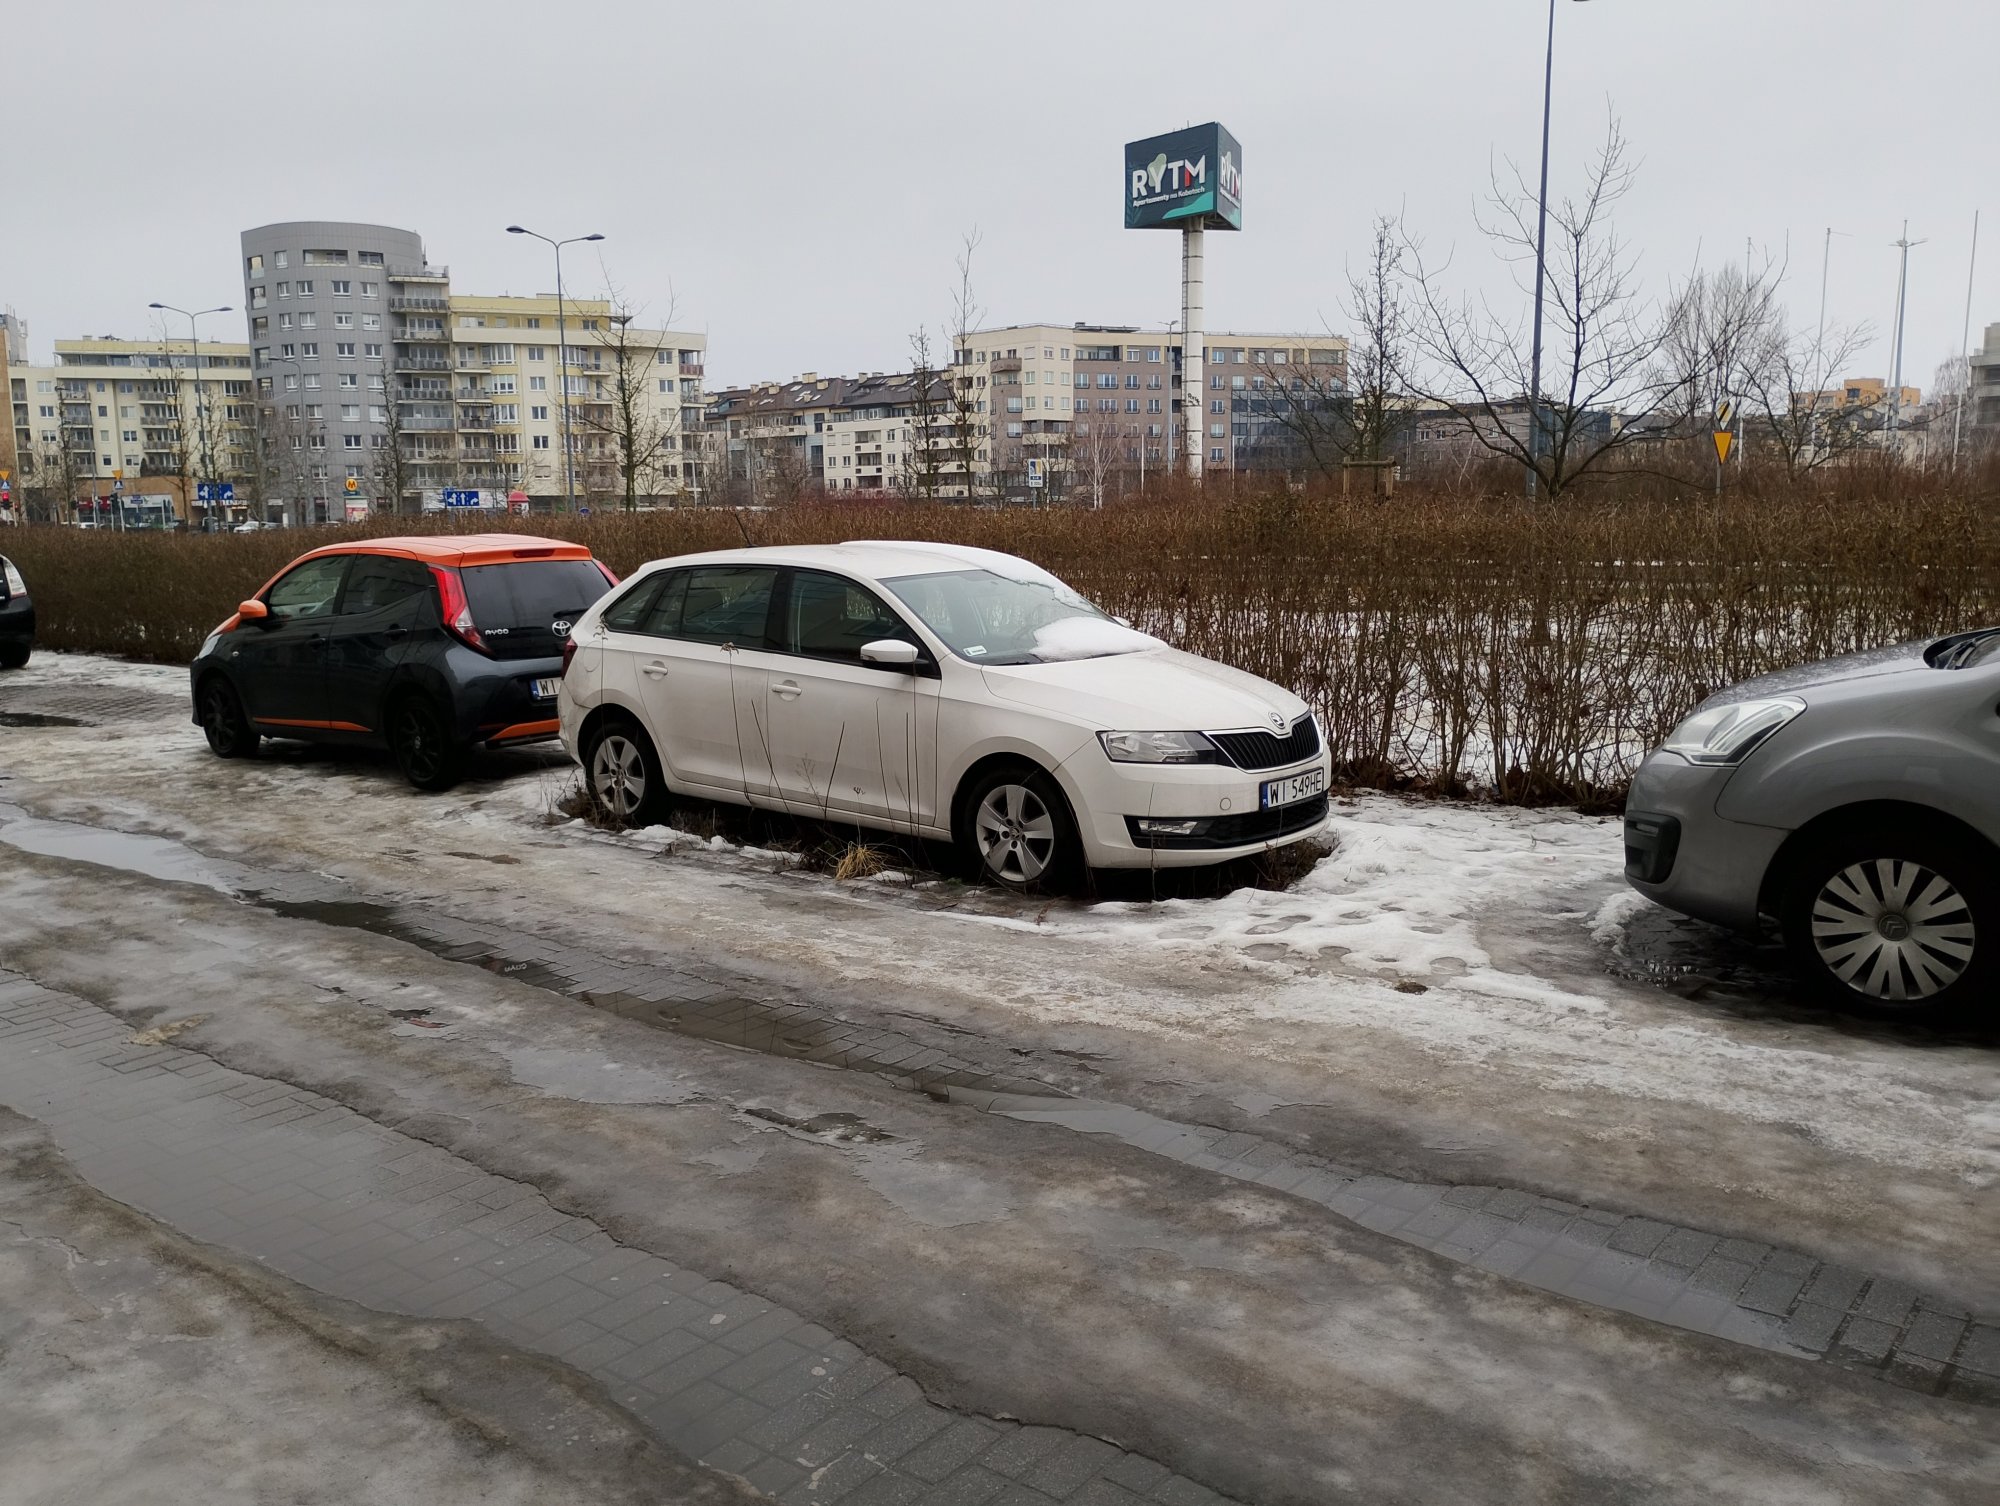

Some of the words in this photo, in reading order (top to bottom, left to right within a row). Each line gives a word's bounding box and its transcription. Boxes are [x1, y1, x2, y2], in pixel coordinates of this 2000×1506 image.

[1132, 154, 1206, 199] RYTM
[540, 679, 556, 695] WI
[1270, 781, 1286, 805] WI
[1292, 772, 1322, 799] 549HE
